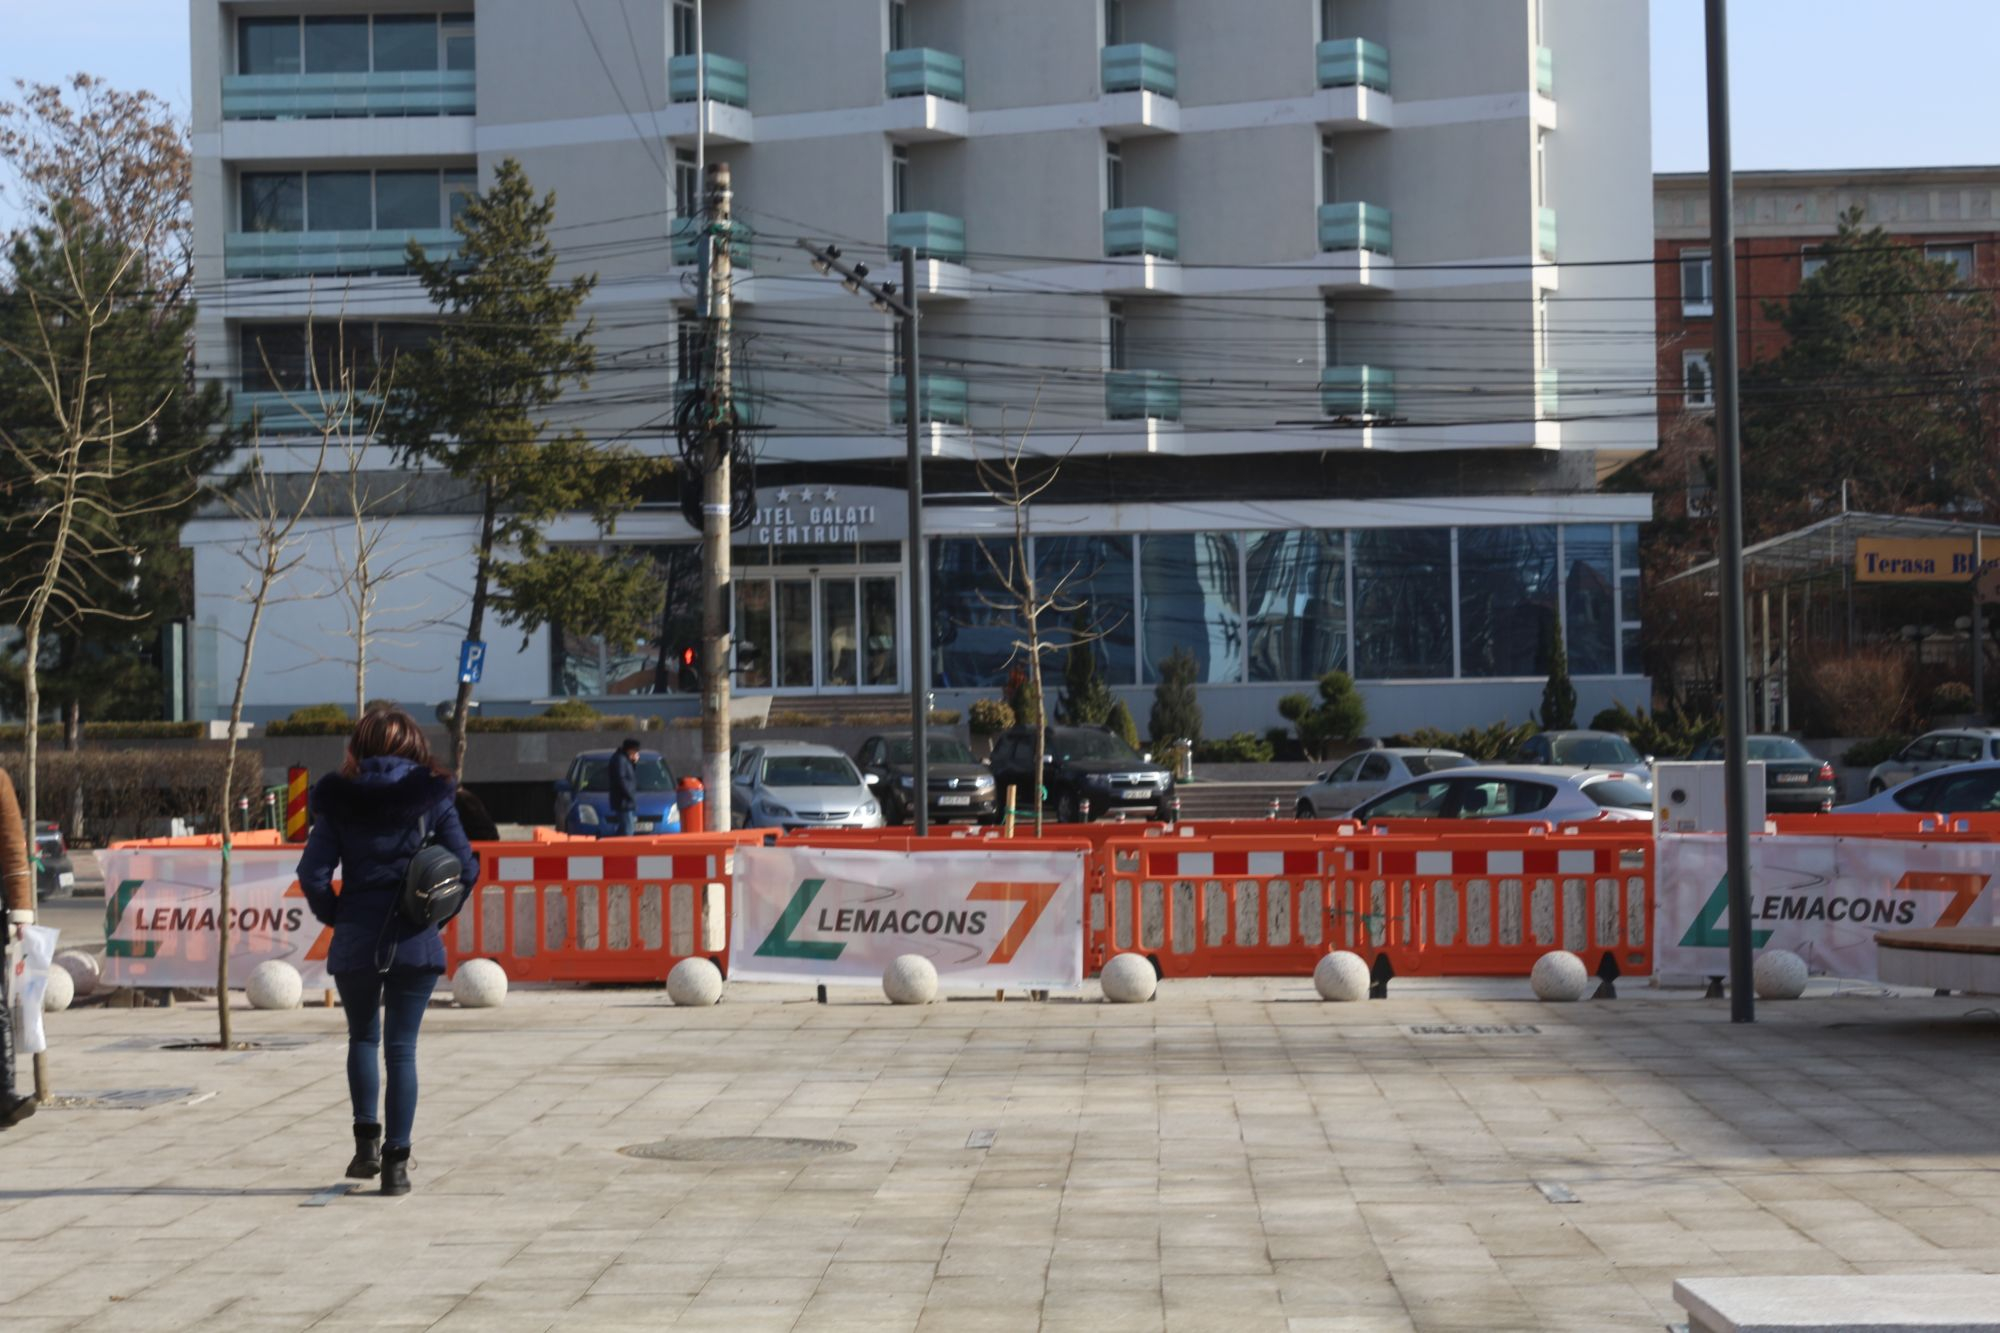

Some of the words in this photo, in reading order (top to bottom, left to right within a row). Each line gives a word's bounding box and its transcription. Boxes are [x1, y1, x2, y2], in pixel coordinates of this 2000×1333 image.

[752, 507, 795, 525] OTEL
[809, 506, 875, 524] GALATI
[760, 525, 859, 544] CENTRUM
[1865, 552, 1935, 574] Terasa
[136, 907, 302, 932] LEMACONS
[817, 908, 988, 934] LEMACONS
[1750, 895, 1917, 925] LEMACONS
